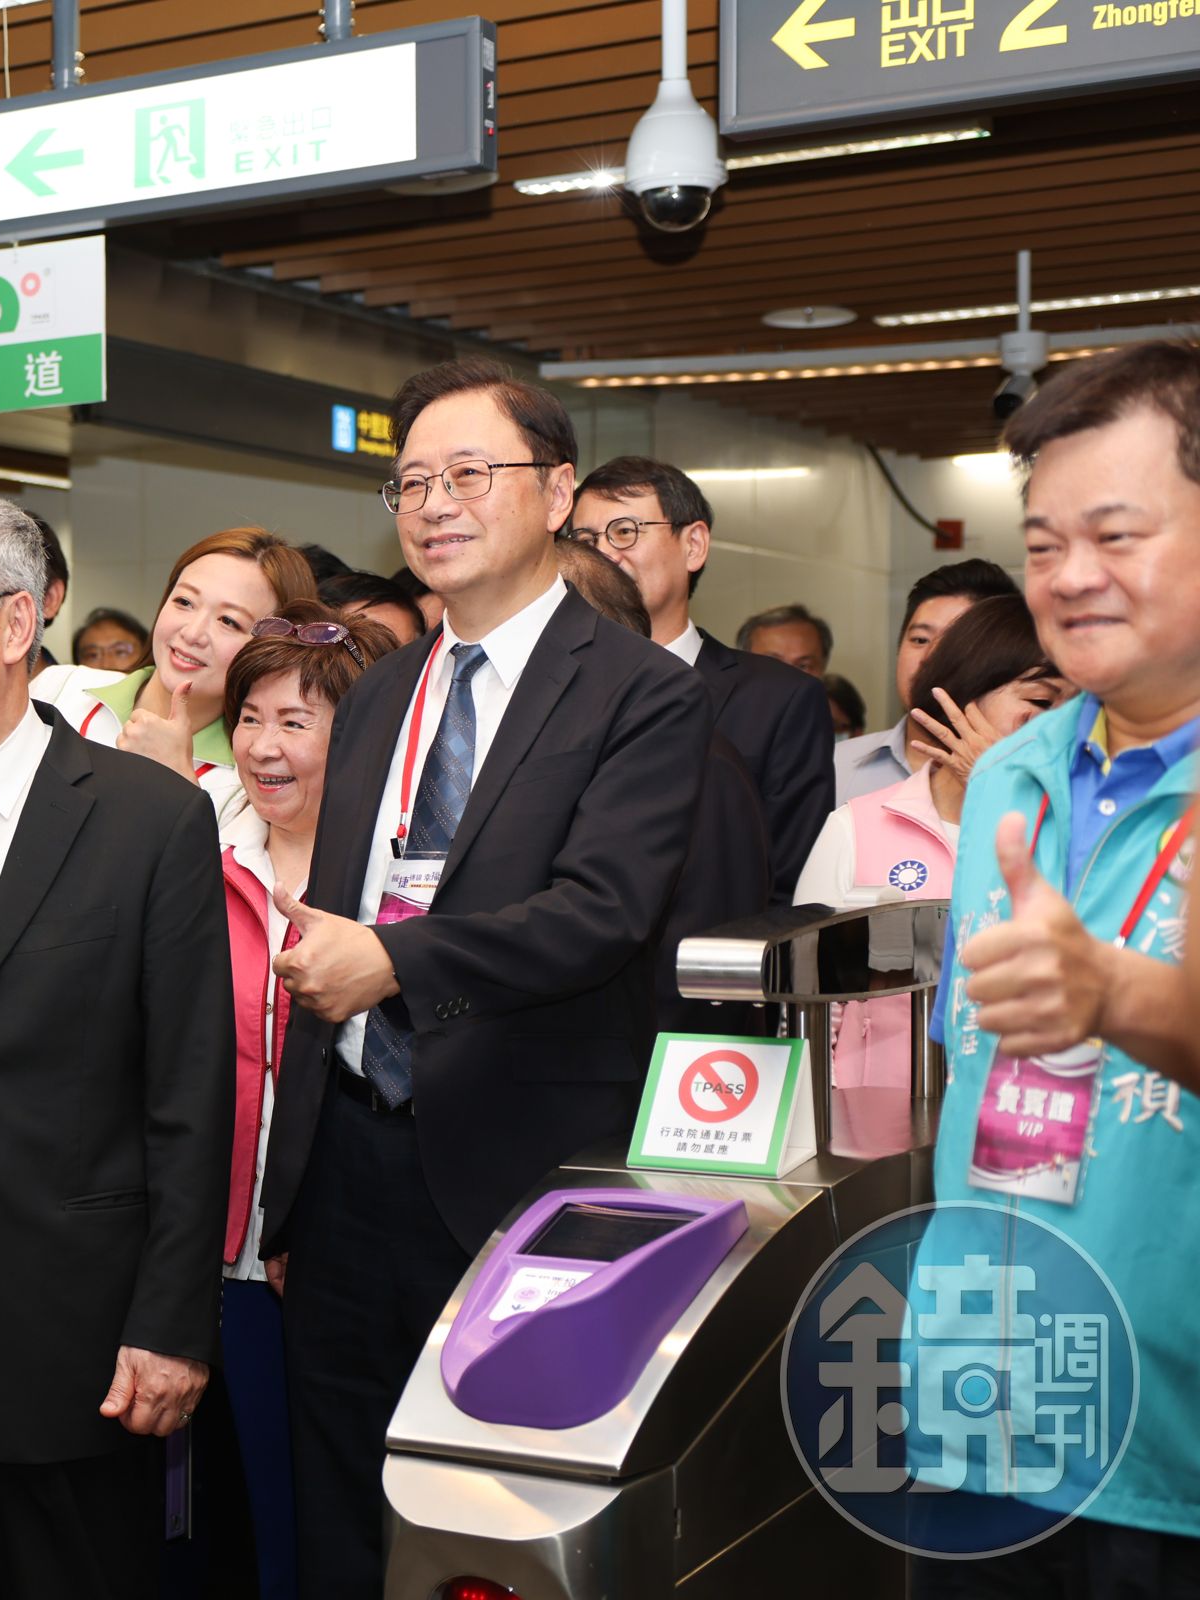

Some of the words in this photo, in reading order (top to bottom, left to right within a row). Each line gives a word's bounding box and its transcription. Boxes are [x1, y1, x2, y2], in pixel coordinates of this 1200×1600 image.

[999, 0, 1068, 52] 2
[881, 22, 975, 68] EXIT
[234, 139, 328, 174] EXIT
[694, 1081, 745, 1095] TPASS
[660, 1126, 753, 1143] 行政院通勤月票
[1017, 1120, 1044, 1138] VIP
[676, 1142, 729, 1156] 請勿感應
